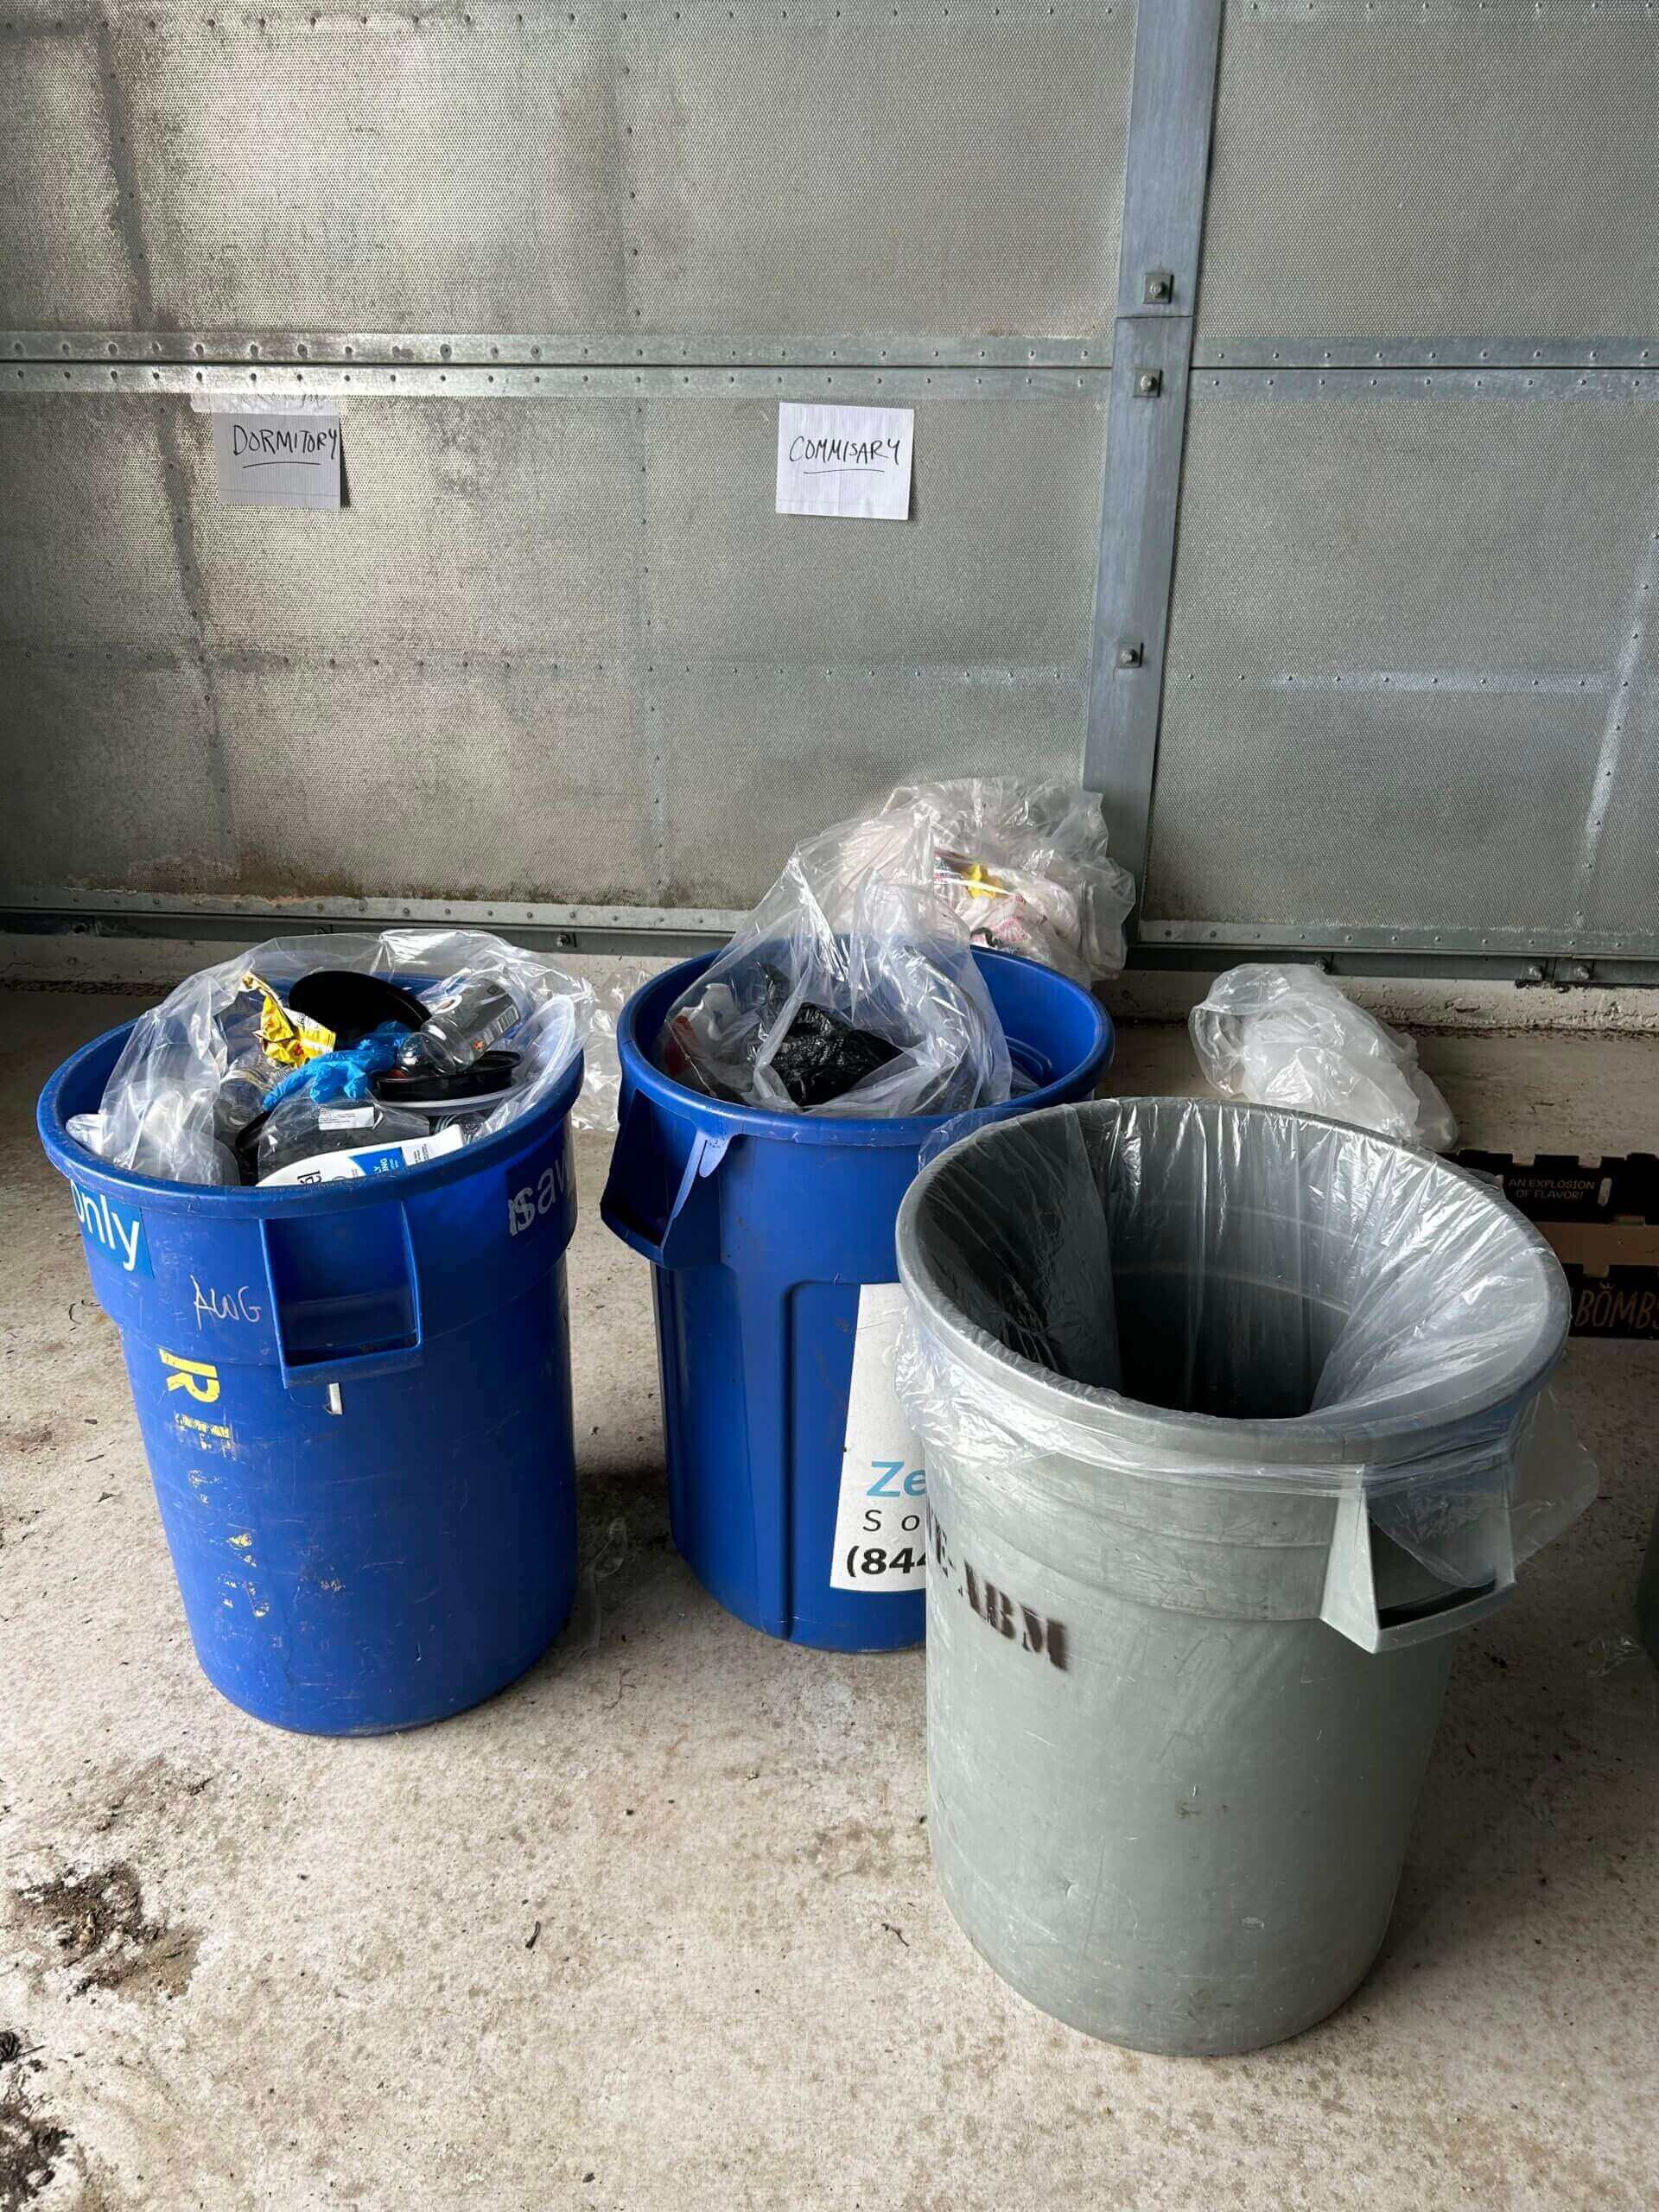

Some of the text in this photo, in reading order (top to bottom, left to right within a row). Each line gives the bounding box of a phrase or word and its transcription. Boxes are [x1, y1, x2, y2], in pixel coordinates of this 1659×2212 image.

[232, 424, 337, 460] DORMITORY
[789, 435, 900, 466] COMMISARY
[1508, 1178, 1596, 1190] AN EXPLOSION
[1516, 1189, 1584, 1200] OF FLAVOR!
[71, 1179, 140, 1271] only
